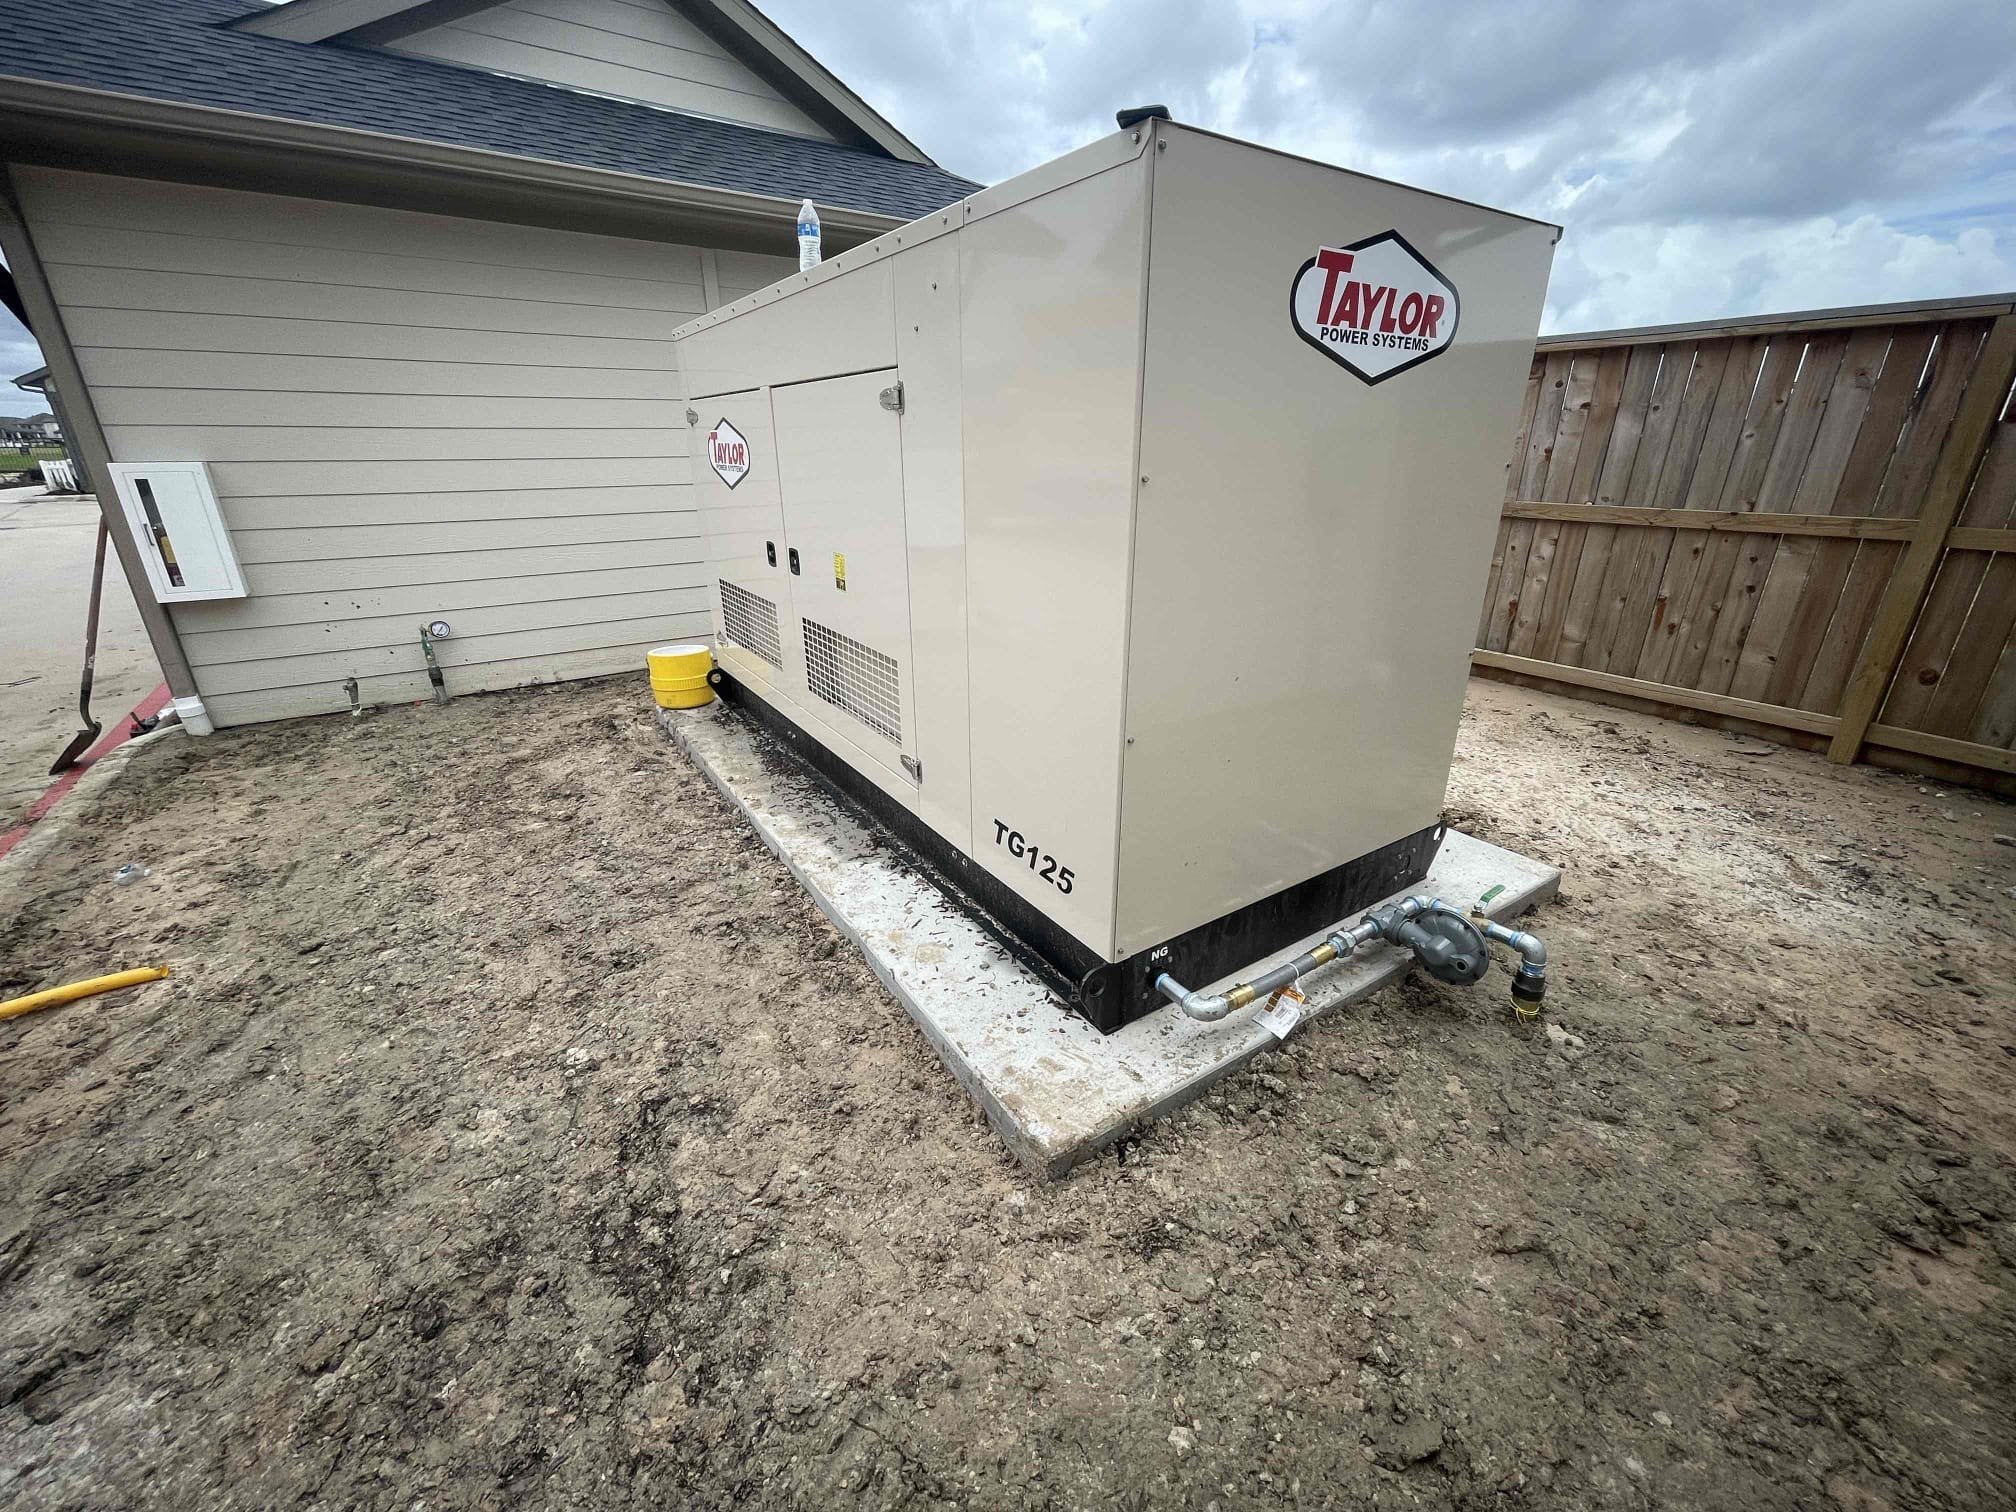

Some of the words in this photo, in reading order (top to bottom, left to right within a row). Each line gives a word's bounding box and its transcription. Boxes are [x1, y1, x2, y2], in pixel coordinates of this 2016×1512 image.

[1316, 249, 1444, 338] TAYLOR
[1320, 327, 1369, 346] POWER
[1372, 333, 1429, 351] SYSTEMS
[709, 431, 745, 465] TAYLOR
[993, 818, 1075, 894] TG125
[1151, 946, 1169, 962] NG
